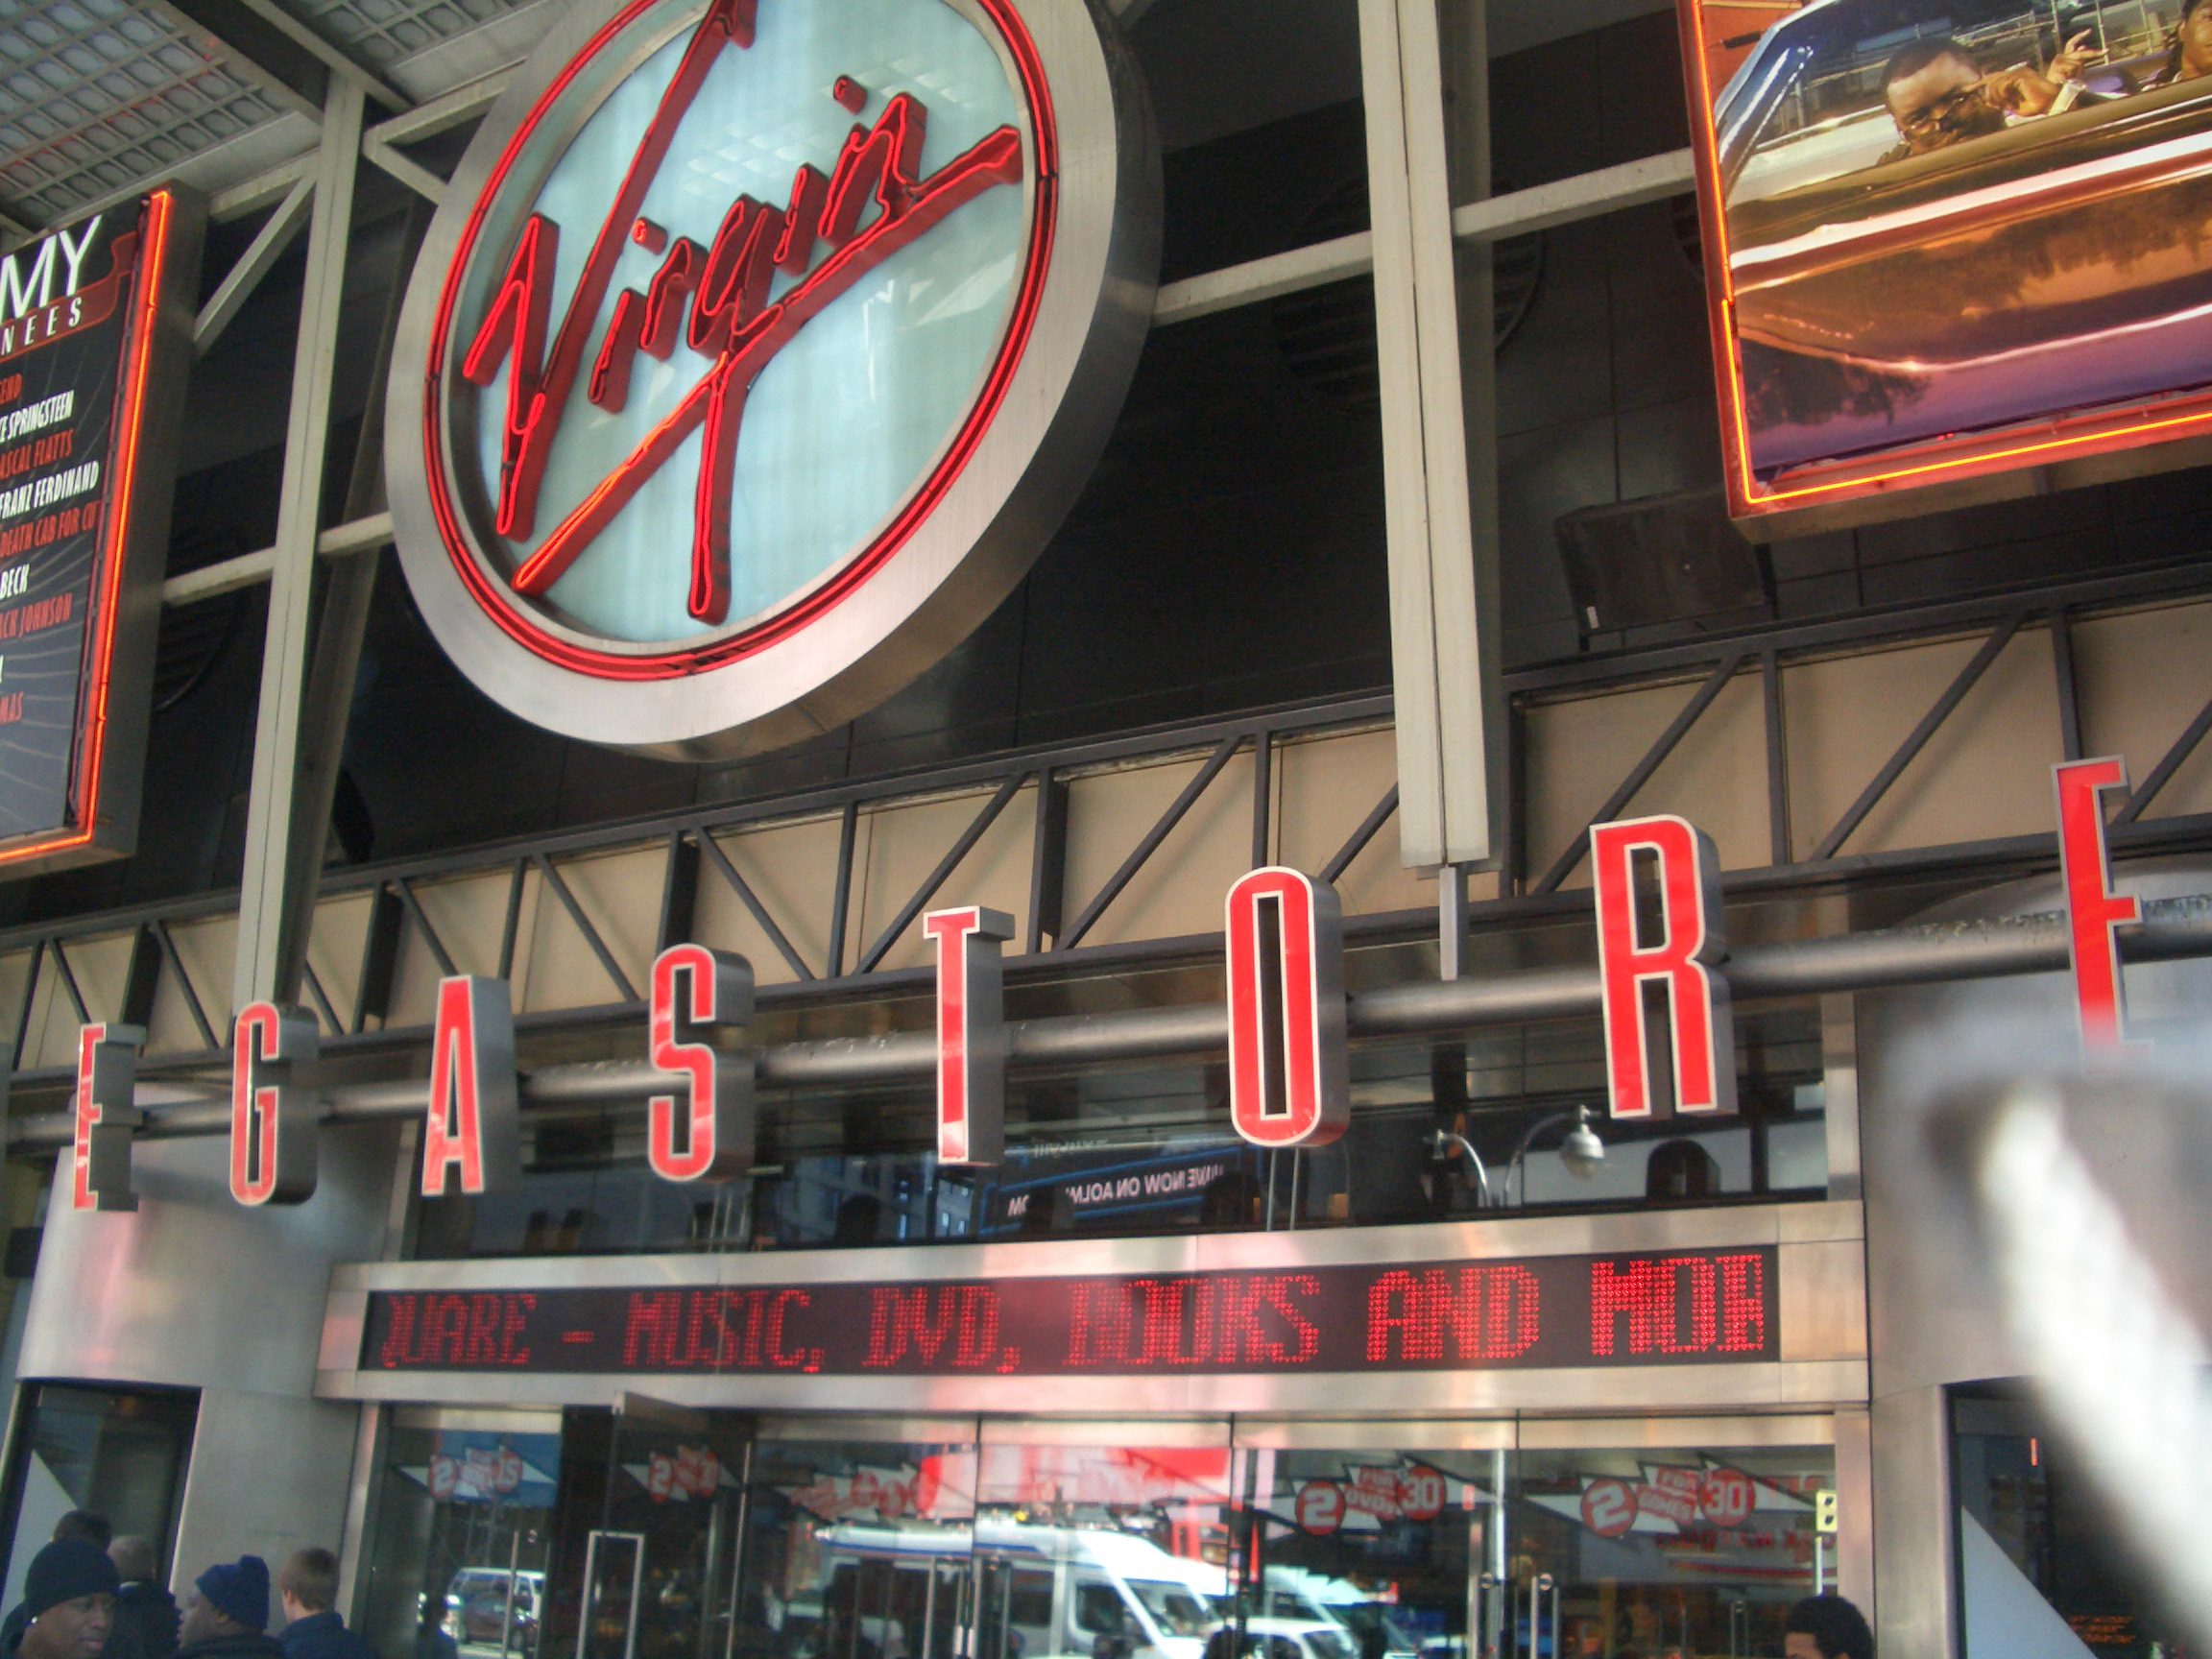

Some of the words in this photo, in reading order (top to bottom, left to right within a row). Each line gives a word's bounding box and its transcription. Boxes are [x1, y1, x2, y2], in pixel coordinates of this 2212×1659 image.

[463, 0, 1024, 626] Virgin
[8, 389, 75, 442] SPRINGSTEEN
[33, 428, 75, 468] FLATTS
[0, 483, 34, 519] FRANZ
[34, 460, 100, 509] FERDINAND
[0, 521, 34, 559] DEATH
[35, 515, 58, 548] CAB
[58, 507, 81, 541] FOR
[0, 563, 31, 601] BECK
[18, 592, 73, 638] JOHNSON
[1061, 1274, 1322, 1366] BOOKS
[1365, 1264, 1540, 1362] AND
[1303, 1488, 1337, 1527] 2
[1587, 1483, 1632, 1530] 2
